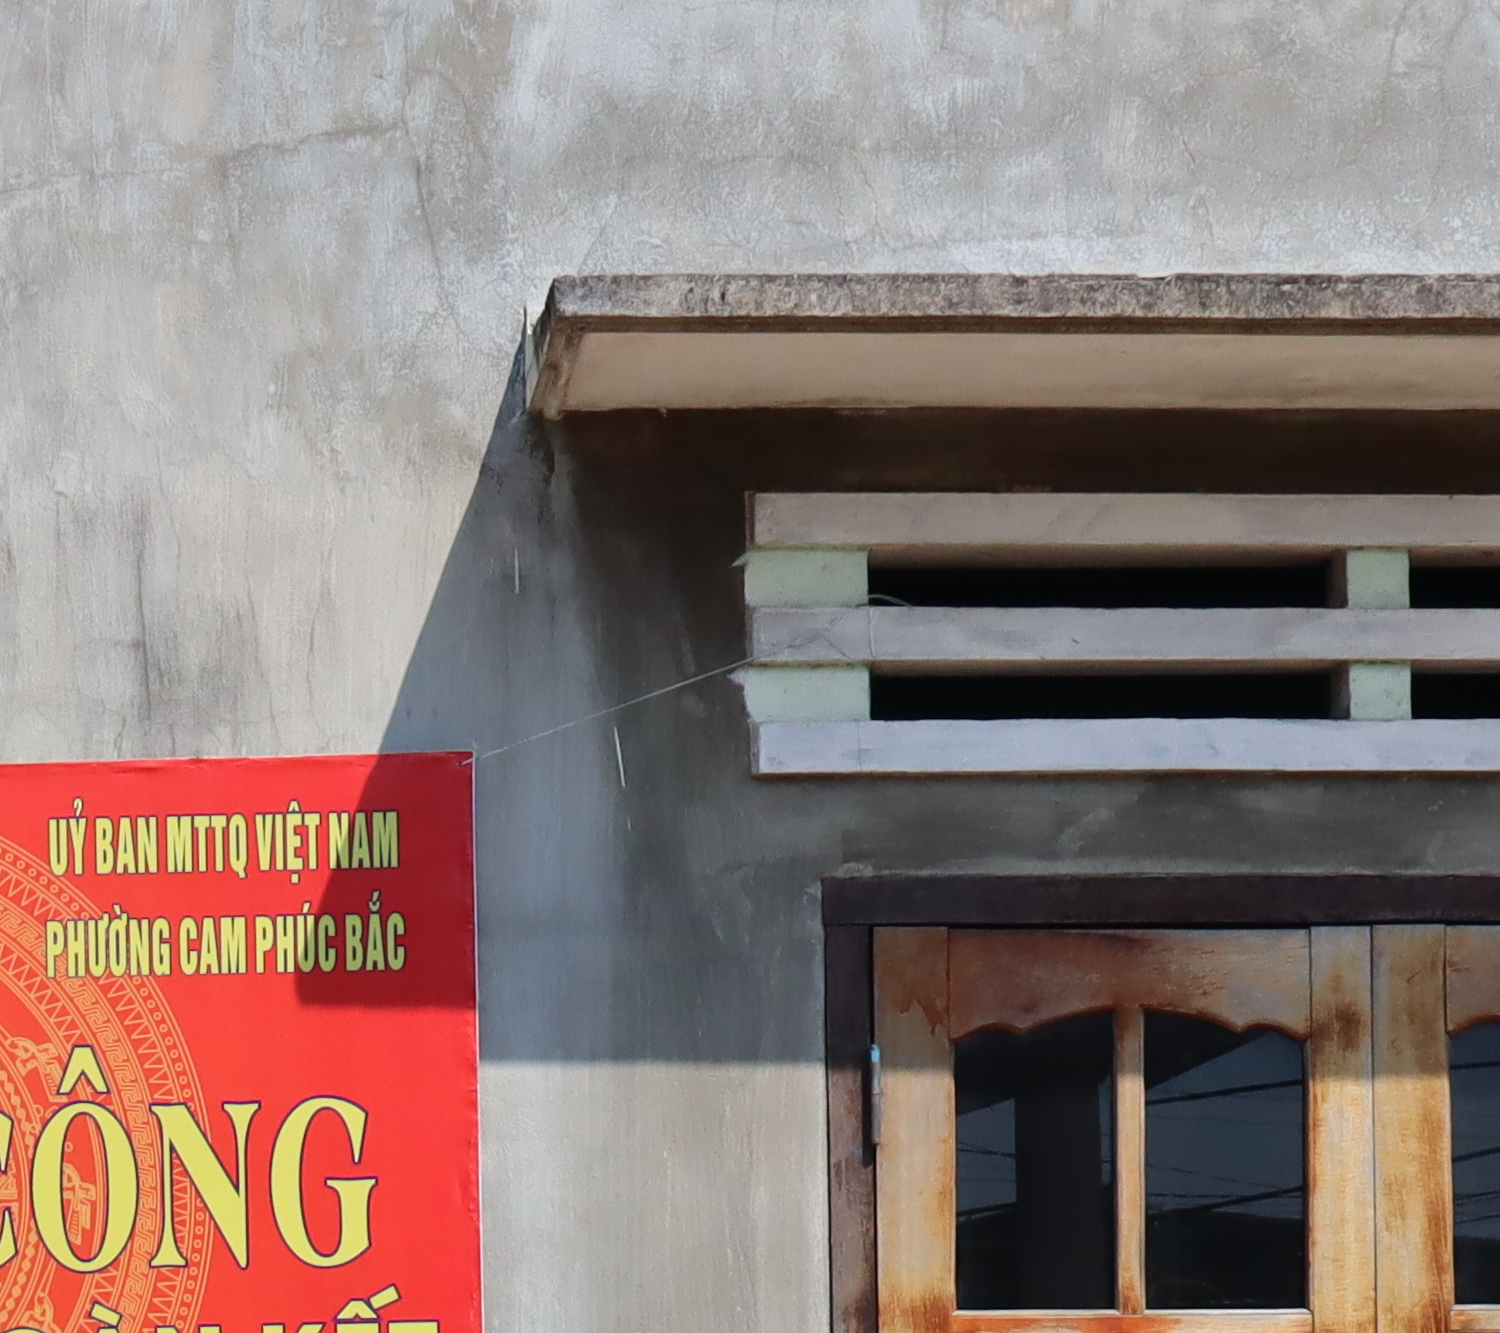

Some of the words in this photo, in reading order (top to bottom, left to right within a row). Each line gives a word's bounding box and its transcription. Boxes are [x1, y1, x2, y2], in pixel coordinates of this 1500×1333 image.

[48, 798, 86, 876] UỶ
[96, 816, 157, 873] BAN
[167, 815, 248, 879] MTTQ
[256, 801, 320, 883] VIỆT
[329, 810, 398, 869] NAM
[47, 904, 170, 977] PHƯỜNG
[179, 916, 246, 974] CAM
[255, 903, 336, 972] PHÚC
[346, 891, 406, 971] BẮC
